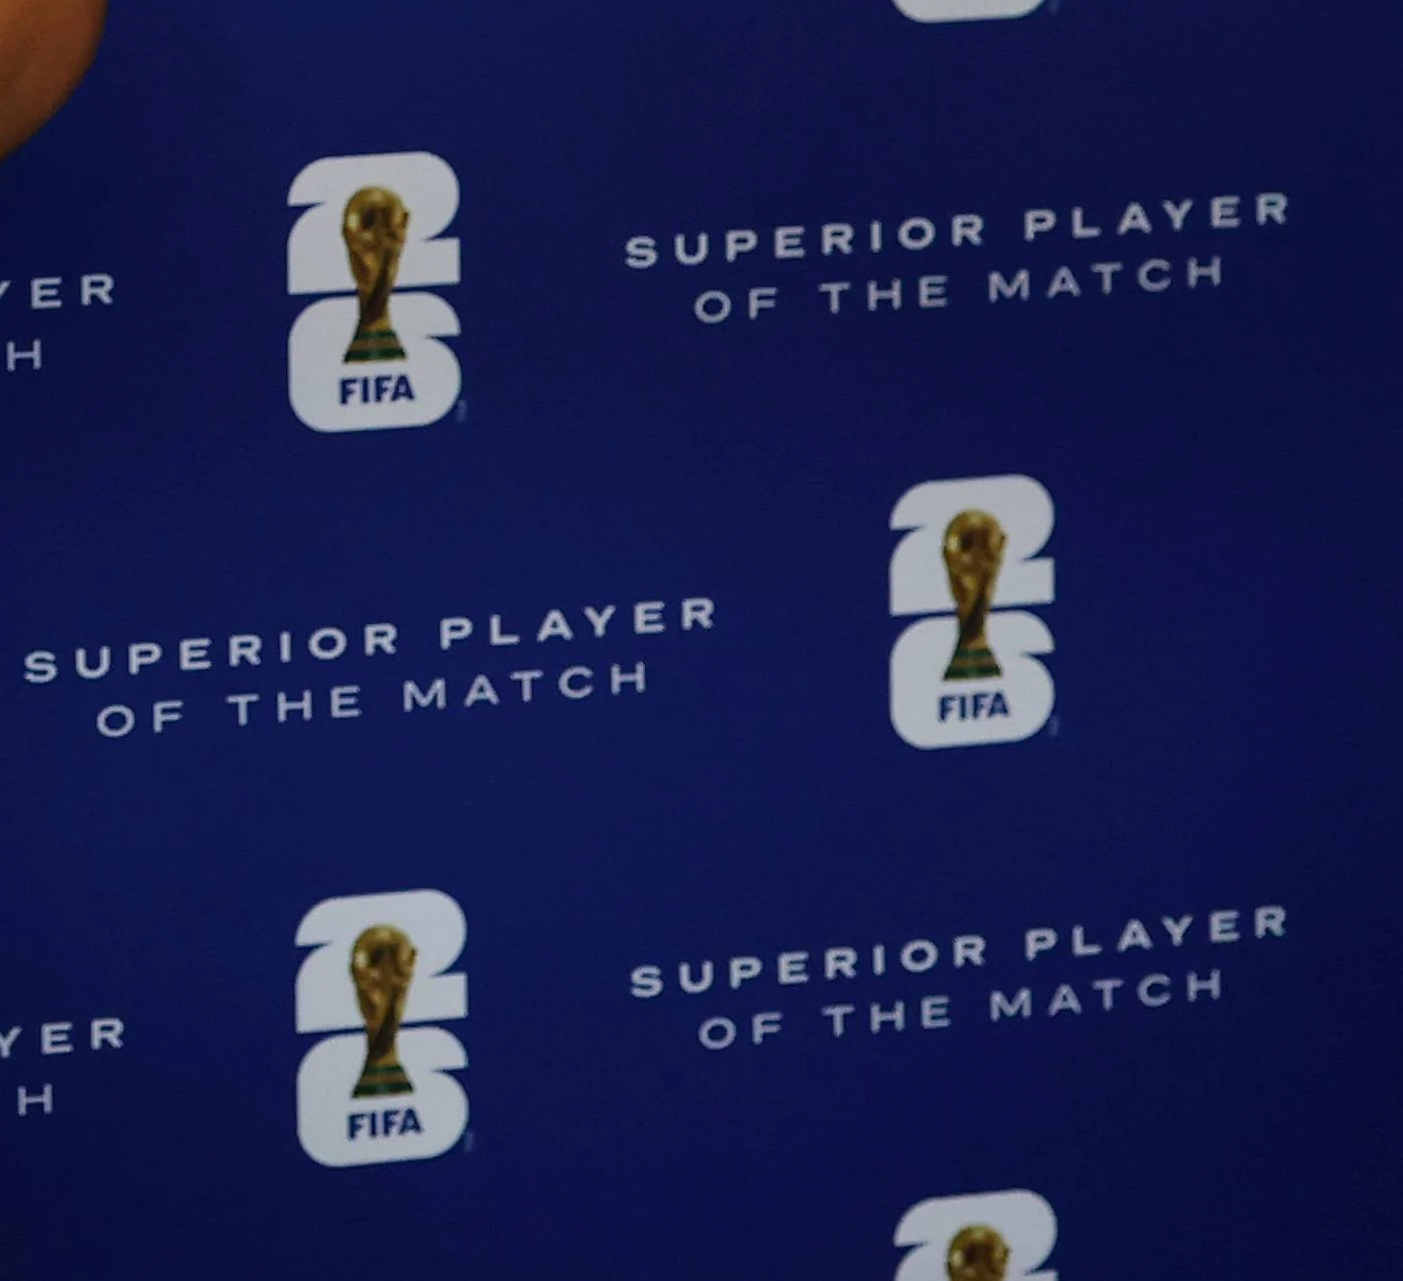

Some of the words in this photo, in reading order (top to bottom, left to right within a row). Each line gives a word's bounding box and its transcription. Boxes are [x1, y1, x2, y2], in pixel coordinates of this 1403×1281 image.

[626, 213, 983, 269] SUPERIOR
[1024, 193, 1287, 240] PLAYER
[694, 287, 777, 323] OF
[820, 275, 946, 314] THE
[989, 258, 1221, 302] MATCH
[337, 373, 416, 406] FIFA
[24, 623, 397, 683] SUPERIOR
[440, 597, 714, 650] PLAYER
[96, 700, 184, 737] OF
[226, 685, 360, 726] THE
[403, 662, 646, 712] MATCH
[631, 935, 985, 998] SUPERIOR
[1025, 906, 1285, 961] PLAYER
[699, 1012, 781, 1049] OF
[823, 996, 949, 1037] THE
[990, 971, 1220, 1021] MATCH
[346, 1106, 424, 1142] FIFA
